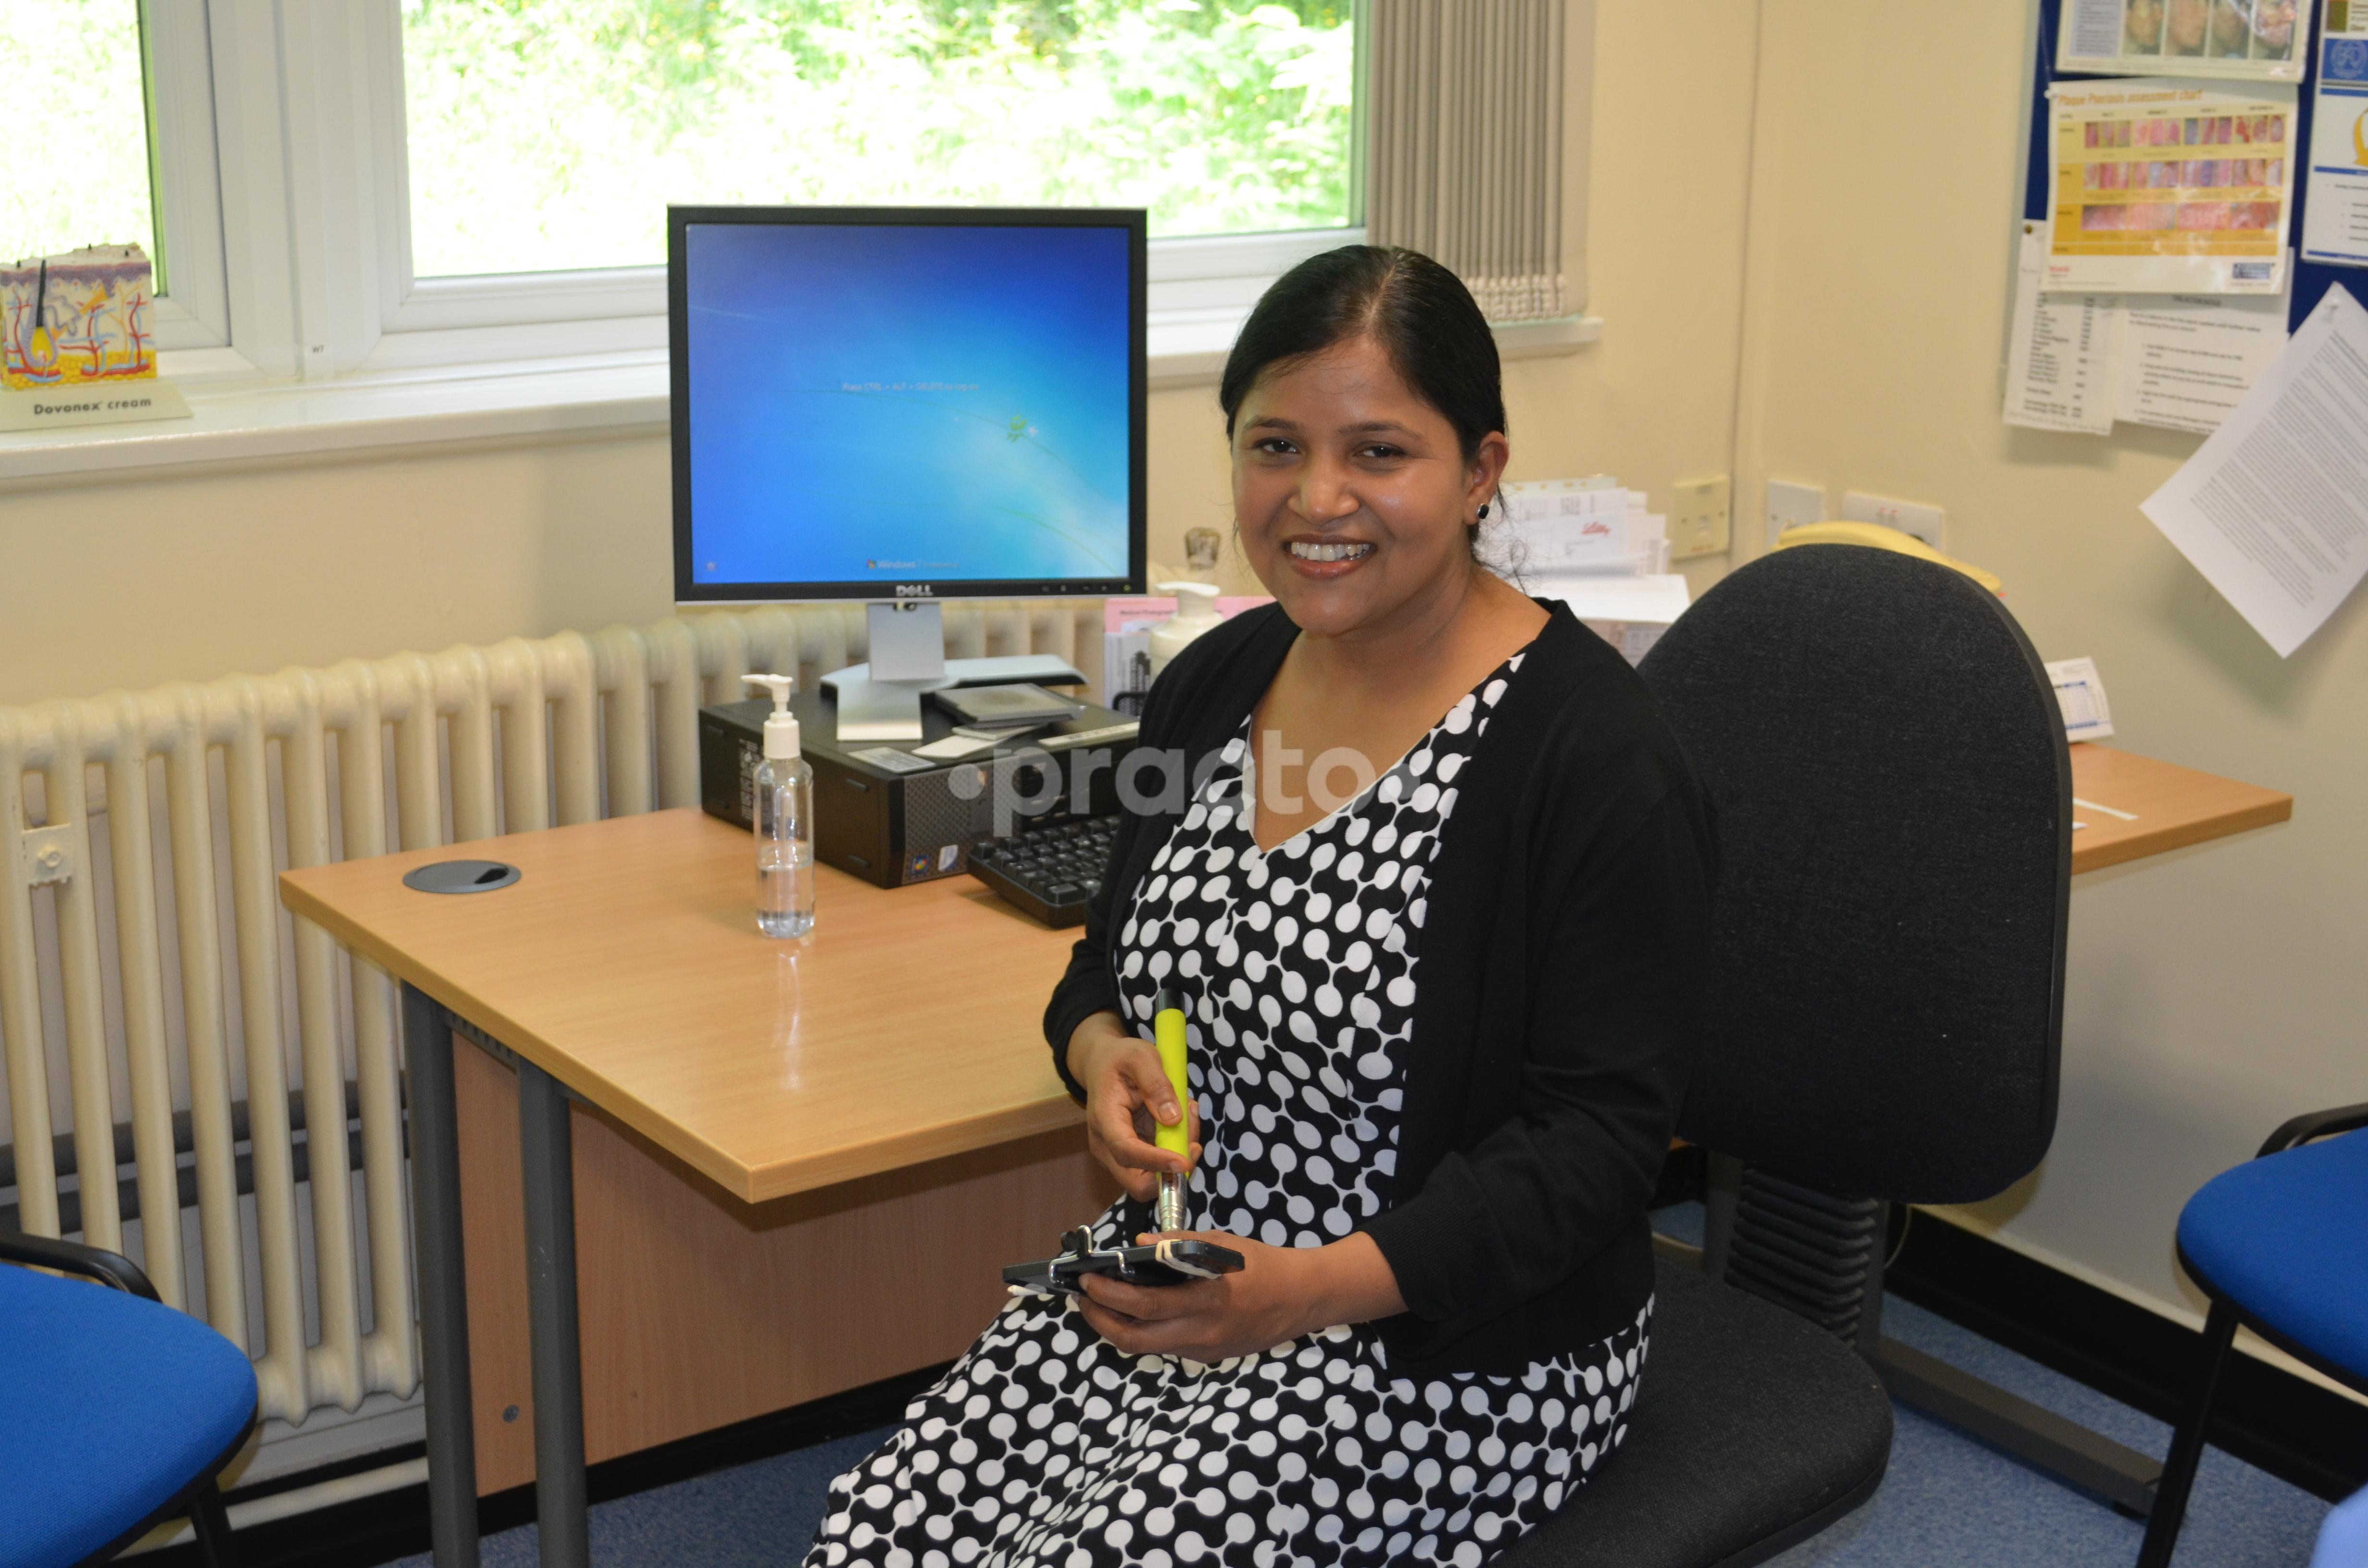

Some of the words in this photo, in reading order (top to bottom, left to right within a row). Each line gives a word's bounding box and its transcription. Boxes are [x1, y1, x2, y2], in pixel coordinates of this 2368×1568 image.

[2058, 94, 2086, 106] Plaque
[2088, 93, 2125, 104] Psoriasis
[2127, 91, 2177, 102] assessment
[2179, 89, 2203, 100] chart
[108, 399, 151, 409] cream
[896, 585, 933, 597] DELL
